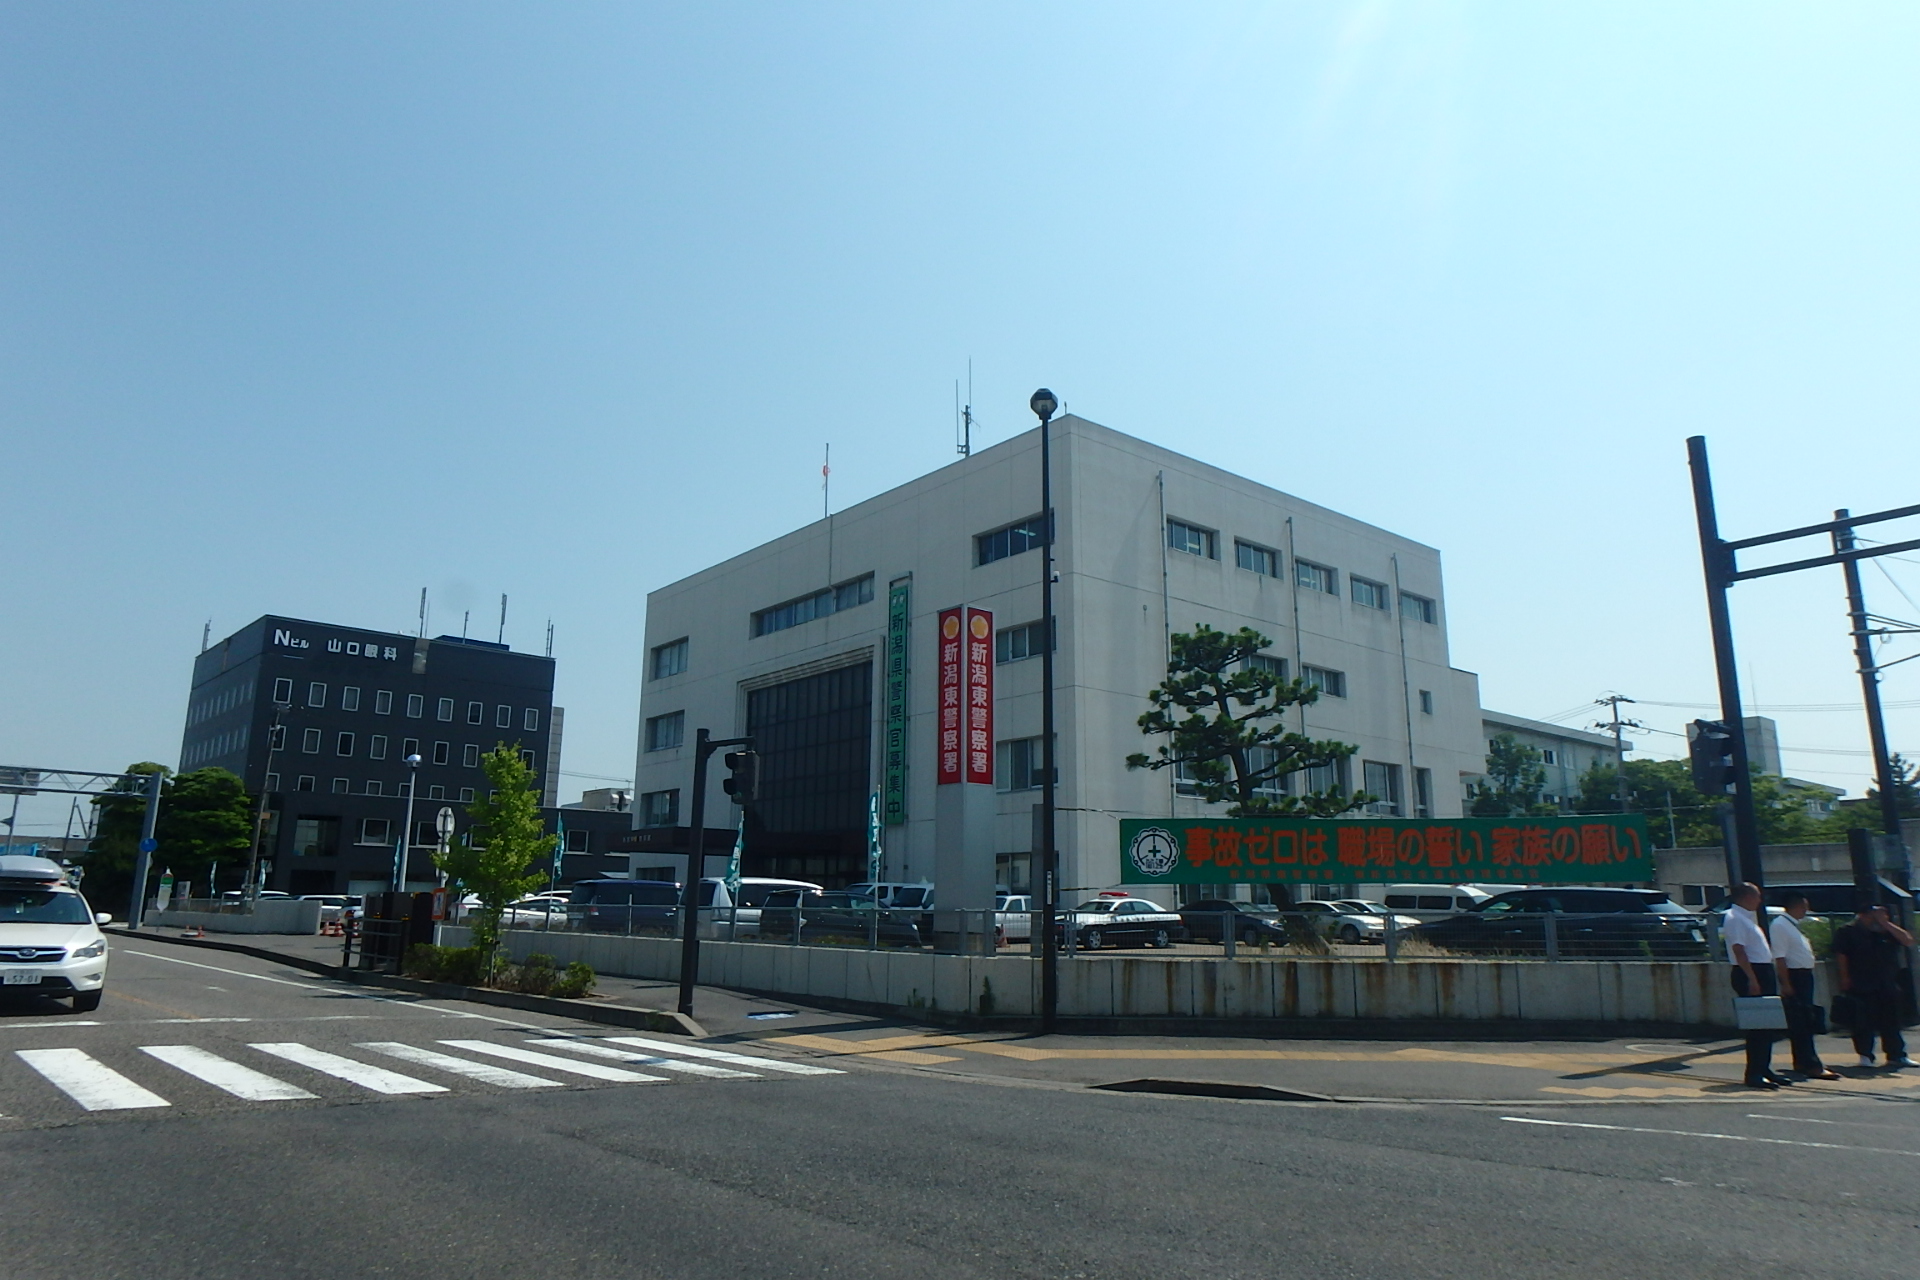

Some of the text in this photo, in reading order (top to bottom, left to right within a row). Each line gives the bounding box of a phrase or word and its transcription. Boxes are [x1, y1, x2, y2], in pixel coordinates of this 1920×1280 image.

[327, 638, 397, 661] 山口眼科
[888, 612, 903, 818] 新潟県警察官募集中
[944, 642, 958, 773] 新潟東警察署
[972, 642, 987, 773] 新潟東警察署
[1185, 824, 1642, 868] 事故ゼロは 職場の誓い 家族の願い
